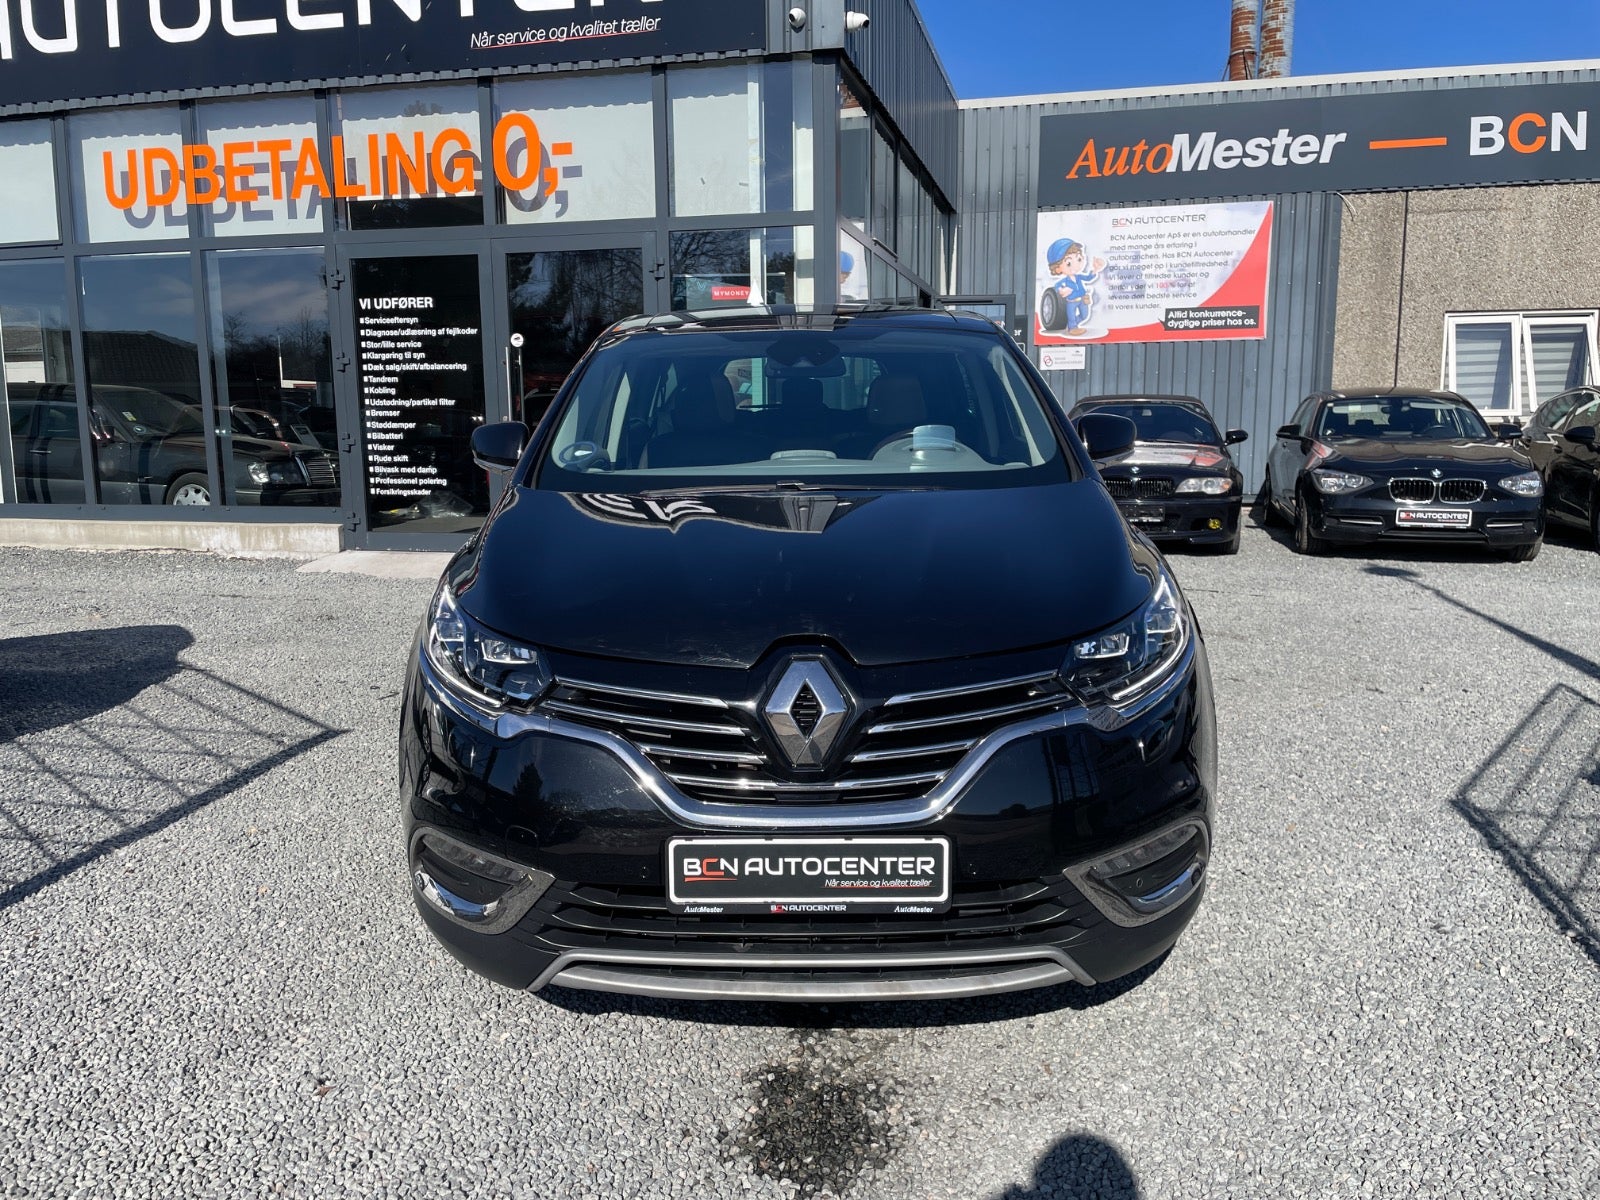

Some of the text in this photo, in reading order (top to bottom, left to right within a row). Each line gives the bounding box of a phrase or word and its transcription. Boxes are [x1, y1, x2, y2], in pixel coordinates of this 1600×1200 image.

[471, 16, 661, 49] Når service og kvalitet tæller
[1066, 111, 1588, 179] AutoMester BCN
[102, 113, 573, 210] UDBETALING 0,-
[1112, 214, 1206, 227] BCN AUTOCENTER
[1128, 243, 1152, 251] mange
[1130, 263, 1153, 271] meget
[1174, 271, 1198, 279] kunder
[1200, 271, 1210, 279] og
[359, 296, 434, 309] VI UDFØRER
[1168, 310, 1247, 319] Altid konkurrence-
[365, 317, 419, 325] Serviceeftersyn
[1168, 318, 1257, 329] dygtige priser hos os.
[438, 327, 445, 335] af
[397, 340, 422, 348] service
[404, 351, 412, 359] til
[413, 352, 426, 361] syn
[369, 375, 399, 383] Tandrem
[370, 387, 396, 395] Kobling
[439, 398, 456, 406] filter
[372, 432, 404, 440] Bilbatteri
[373, 443, 395, 451] Visker
[417, 466, 438, 475] damp
[376, 477, 447, 487] Professionel polering
[1417, 512, 1469, 520] AUTOCENTER
[684, 857, 935, 876] BCN AUTOCENTER
[825, 878, 932, 889] Når service og kvalitet tæller
[684, 905, 724, 913] AutoMester
[771, 904, 847, 912] BCN AUTOCENTER
[894, 905, 934, 913] AutoMester
